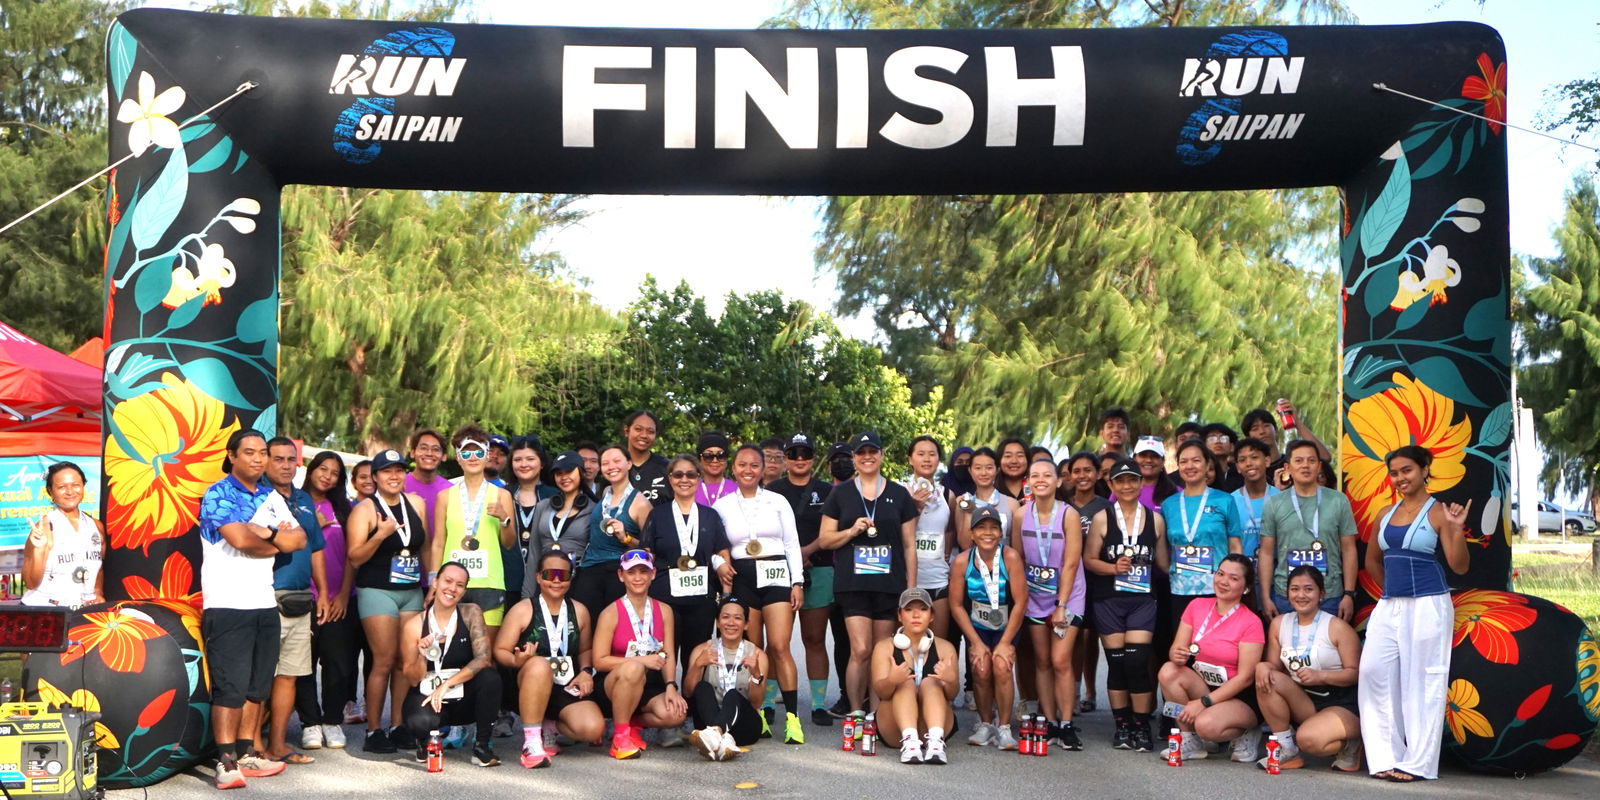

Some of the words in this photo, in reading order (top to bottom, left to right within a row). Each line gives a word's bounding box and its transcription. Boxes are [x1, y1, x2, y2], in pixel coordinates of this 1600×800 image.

[328, 54, 467, 96] RUN
[1179, 57, 1305, 96] RUN
[562, 45, 1087, 149] FINISH
[355, 114, 463, 142] SAIPAN
[1199, 113, 1305, 141] SAIPAN
[916, 539, 937, 551] 1976
[858, 547, 889, 558] 2110
[1179, 547, 1210, 558] 212
[1292, 550, 1324, 561] 2113
[765, 567, 786, 580] 1972
[1028, 566, 1055, 579] 203
[679, 574, 704, 588] 1958
